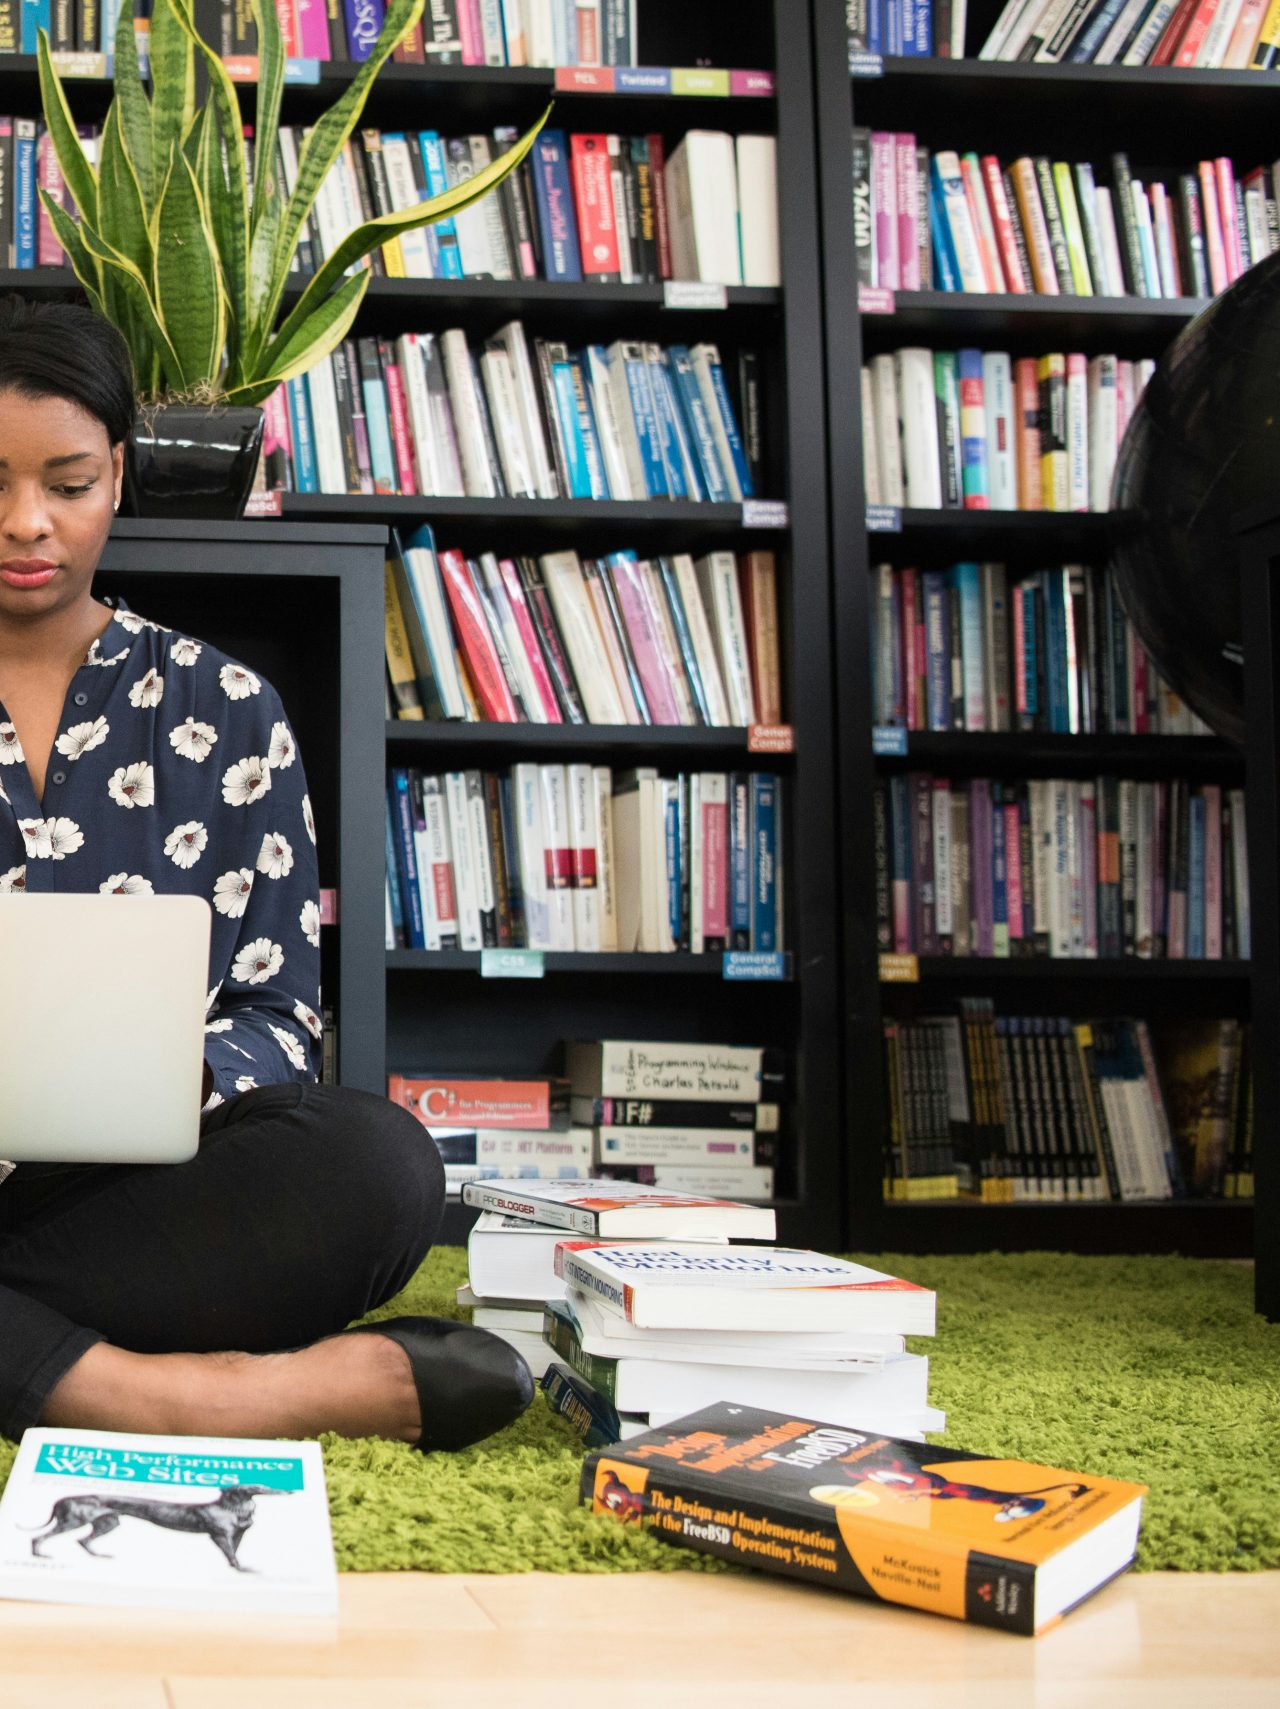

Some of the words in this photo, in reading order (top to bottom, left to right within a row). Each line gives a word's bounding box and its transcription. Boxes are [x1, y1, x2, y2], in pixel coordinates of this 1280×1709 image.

[621, 75, 667, 86] Twisted
[17, 143, 33, 214] Programming
[597, 153, 613, 230] Programming
[640, 207, 655, 241] Python
[501, 956, 525, 966] CSS
[730, 952, 776, 963] General
[727, 964, 780, 978] CompSci
[637, 1053, 706, 1075] Programming
[642, 1076, 693, 1091] Charles
[474, 1100, 532, 1110] Programmers
[626, 1102, 653, 1124] F#
[535, 1141, 573, 1154] Platform
[483, 1195, 535, 1215] PROBLOGGER
[592, 1248, 684, 1259] Host
[602, 1252, 774, 1266] Integrity
[611, 1260, 852, 1276] Monitoring
[593, 1276, 624, 1308] MONITORING
[47, 1444, 112, 1465] High
[122, 1450, 294, 1472] Performance
[45, 1456, 135, 1479] Web
[147, 1465, 240, 1486] Sites
[650, 1489, 672, 1510] The
[673, 1496, 713, 1520] Design
[714, 1506, 738, 1527] and
[738, 1511, 837, 1552] Implementation
[662, 1512, 682, 1532] the
[682, 1518, 731, 1545] FreeBSD
[731, 1531, 793, 1564] Operating
[793, 1548, 838, 1573] System
[882, 1553, 941, 1579] McKusick
[870, 1567, 942, 1592] Neville-Neil
